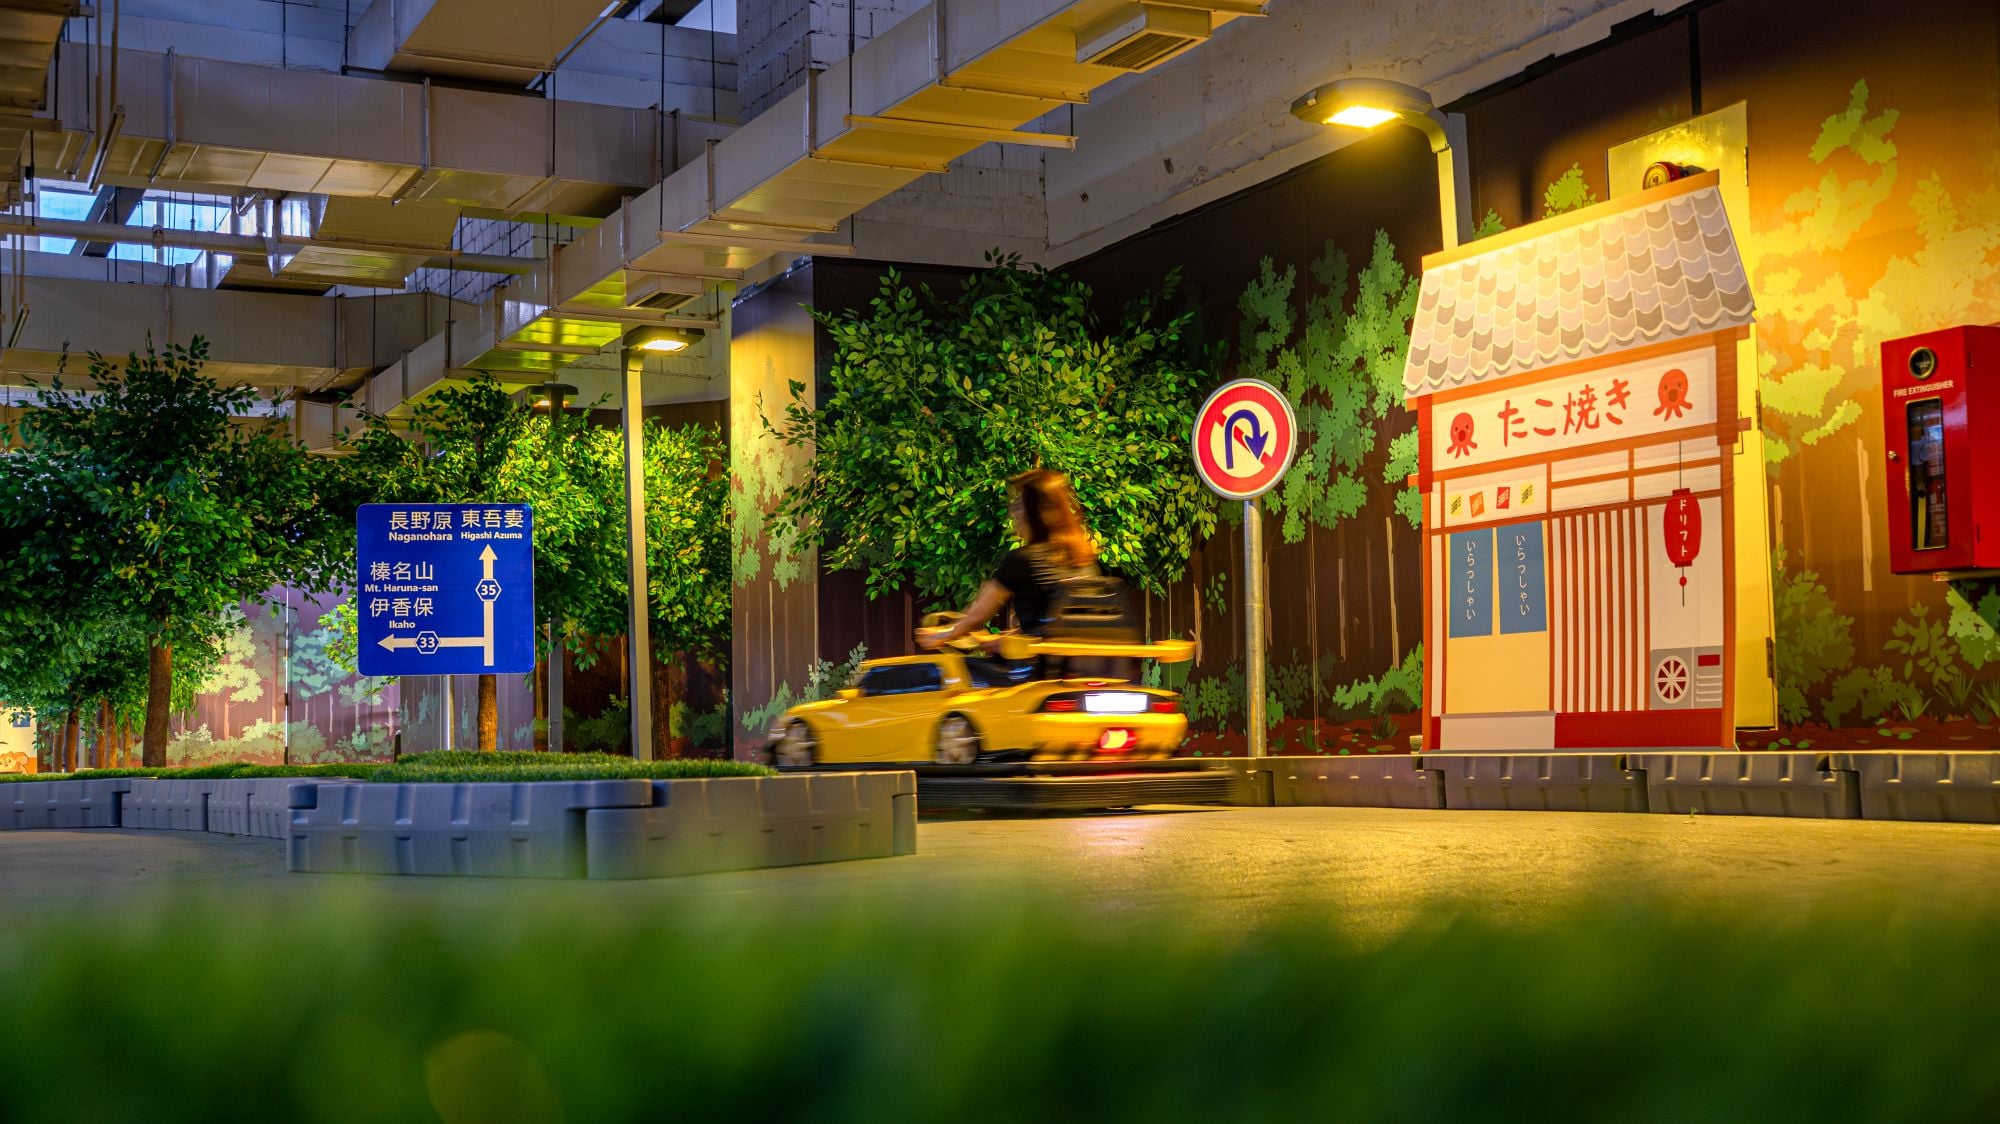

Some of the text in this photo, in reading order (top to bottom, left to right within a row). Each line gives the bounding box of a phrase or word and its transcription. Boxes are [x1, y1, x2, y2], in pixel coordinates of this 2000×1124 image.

[1893, 380, 1954, 397] FIRE EXTINGUISHER
[1498, 379, 1631, 447] たこ焼き
[389, 511, 453, 530] 長野原
[461, 509, 524, 528] 東吾妻
[461, 531, 523, 541] Higashi Azuma
[1680, 499, 1688, 557] ドリフト
[389, 532, 453, 543] Naganohara
[370, 561, 434, 581] 榛名山
[364, 584, 439, 592] Mt. Haruna-san
[480, 585, 496, 596] 35
[369, 597, 434, 618] 伊香保
[389, 620, 416, 629] Ikaho
[419, 637, 436, 648] 33
